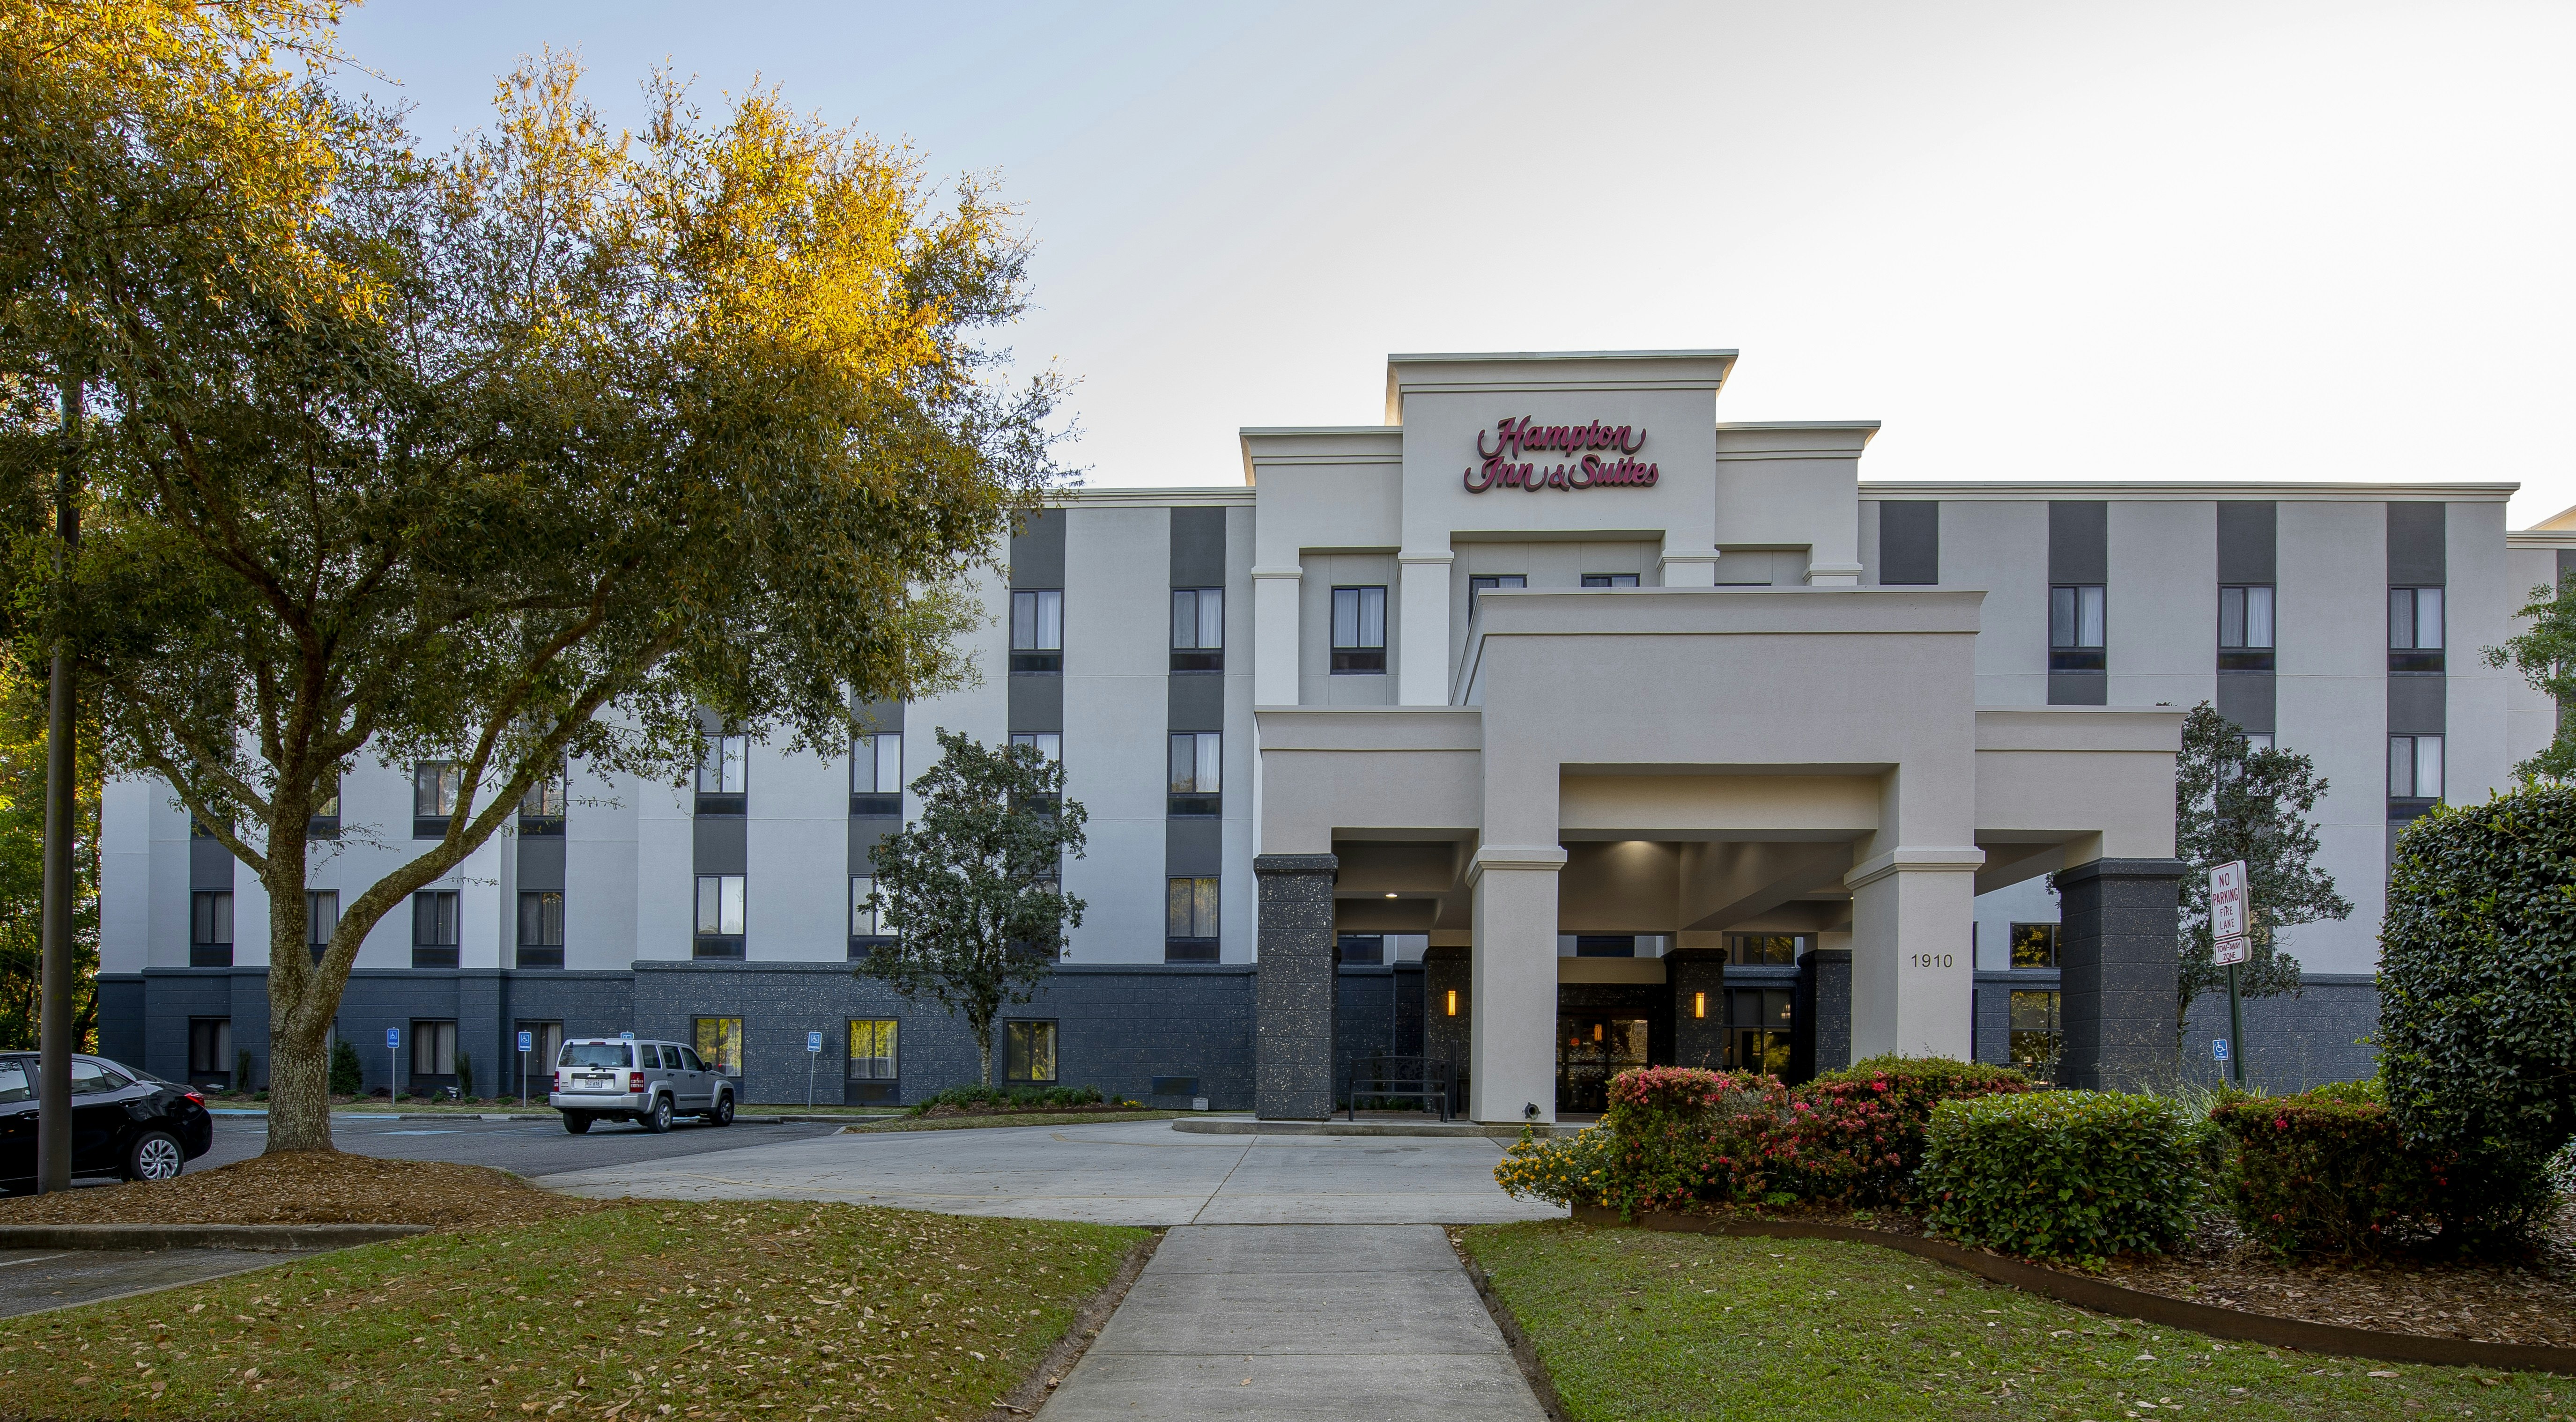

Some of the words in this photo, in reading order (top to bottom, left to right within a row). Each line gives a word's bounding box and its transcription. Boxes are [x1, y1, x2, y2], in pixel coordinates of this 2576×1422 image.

[1477, 415, 1646, 460] Hampton
[1464, 455, 1548, 494] Inn
[1547, 464, 1570, 492] &
[1568, 453, 1659, 490] Suites
[2219, 872, 2230, 888] NO
[2213, 887, 2238, 907] PARKING
[2220, 906, 2233, 918] FIRE
[2220, 918, 2235, 930] LANE
[2216, 942, 2241, 953] TOW-AWAY
[1911, 954, 1953, 968] 1910
[2223, 951, 2236, 960] ZONE
